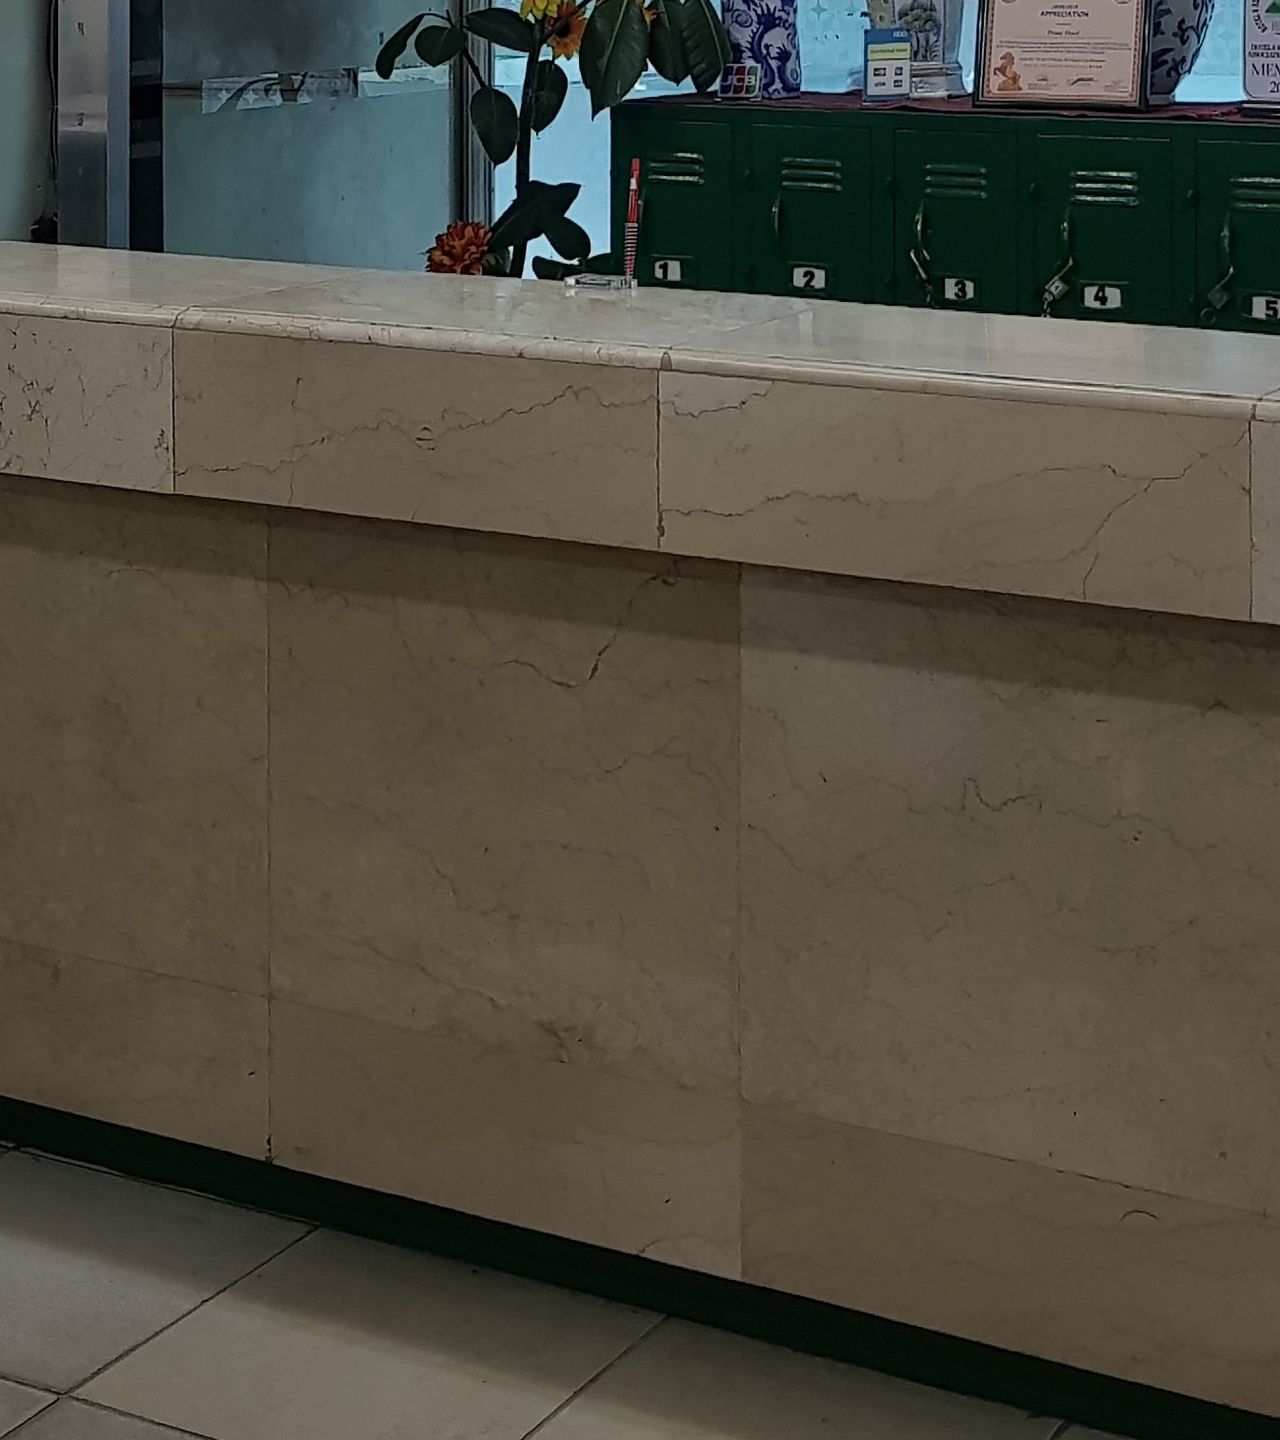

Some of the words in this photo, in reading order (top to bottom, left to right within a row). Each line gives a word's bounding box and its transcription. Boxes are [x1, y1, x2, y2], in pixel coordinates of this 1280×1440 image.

[660, 262, 669, 280] 1
[803, 270, 815, 289] 2
[954, 279, 968, 299] 3
[1093, 284, 1108, 306] 4
[1264, 299, 1278, 319] 5
